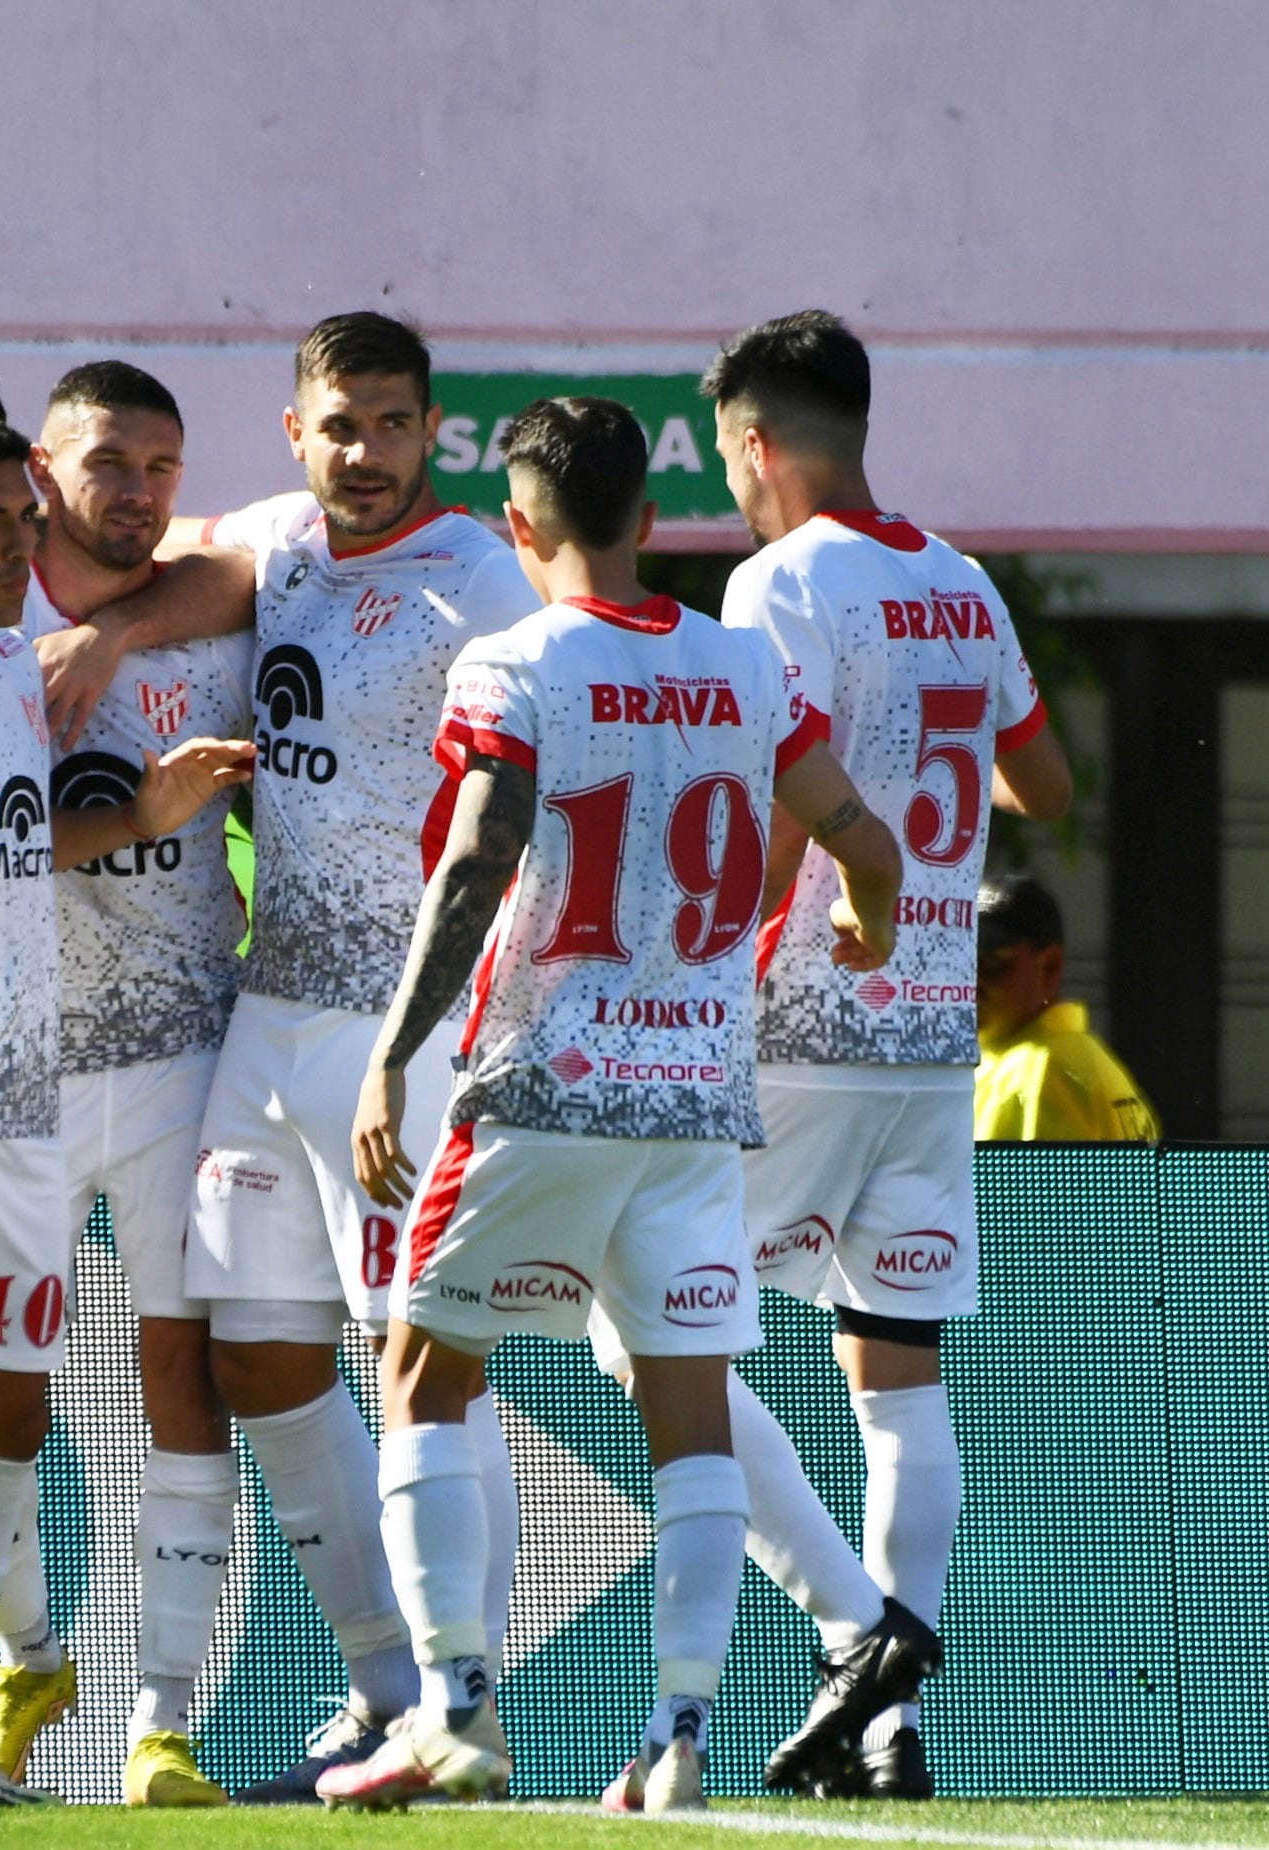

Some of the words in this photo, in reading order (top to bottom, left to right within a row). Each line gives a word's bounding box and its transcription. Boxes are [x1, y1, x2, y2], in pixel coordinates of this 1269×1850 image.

[878, 599, 997, 641] BRAVA
[587, 683, 743, 727] BRAVA
[903, 677, 989, 868] 5
[530, 771, 768, 967] 19
[361, 1214, 398, 1289] 8
[439, 1284, 481, 1305] LYON
[490, 1277, 581, 1305] MICAM
